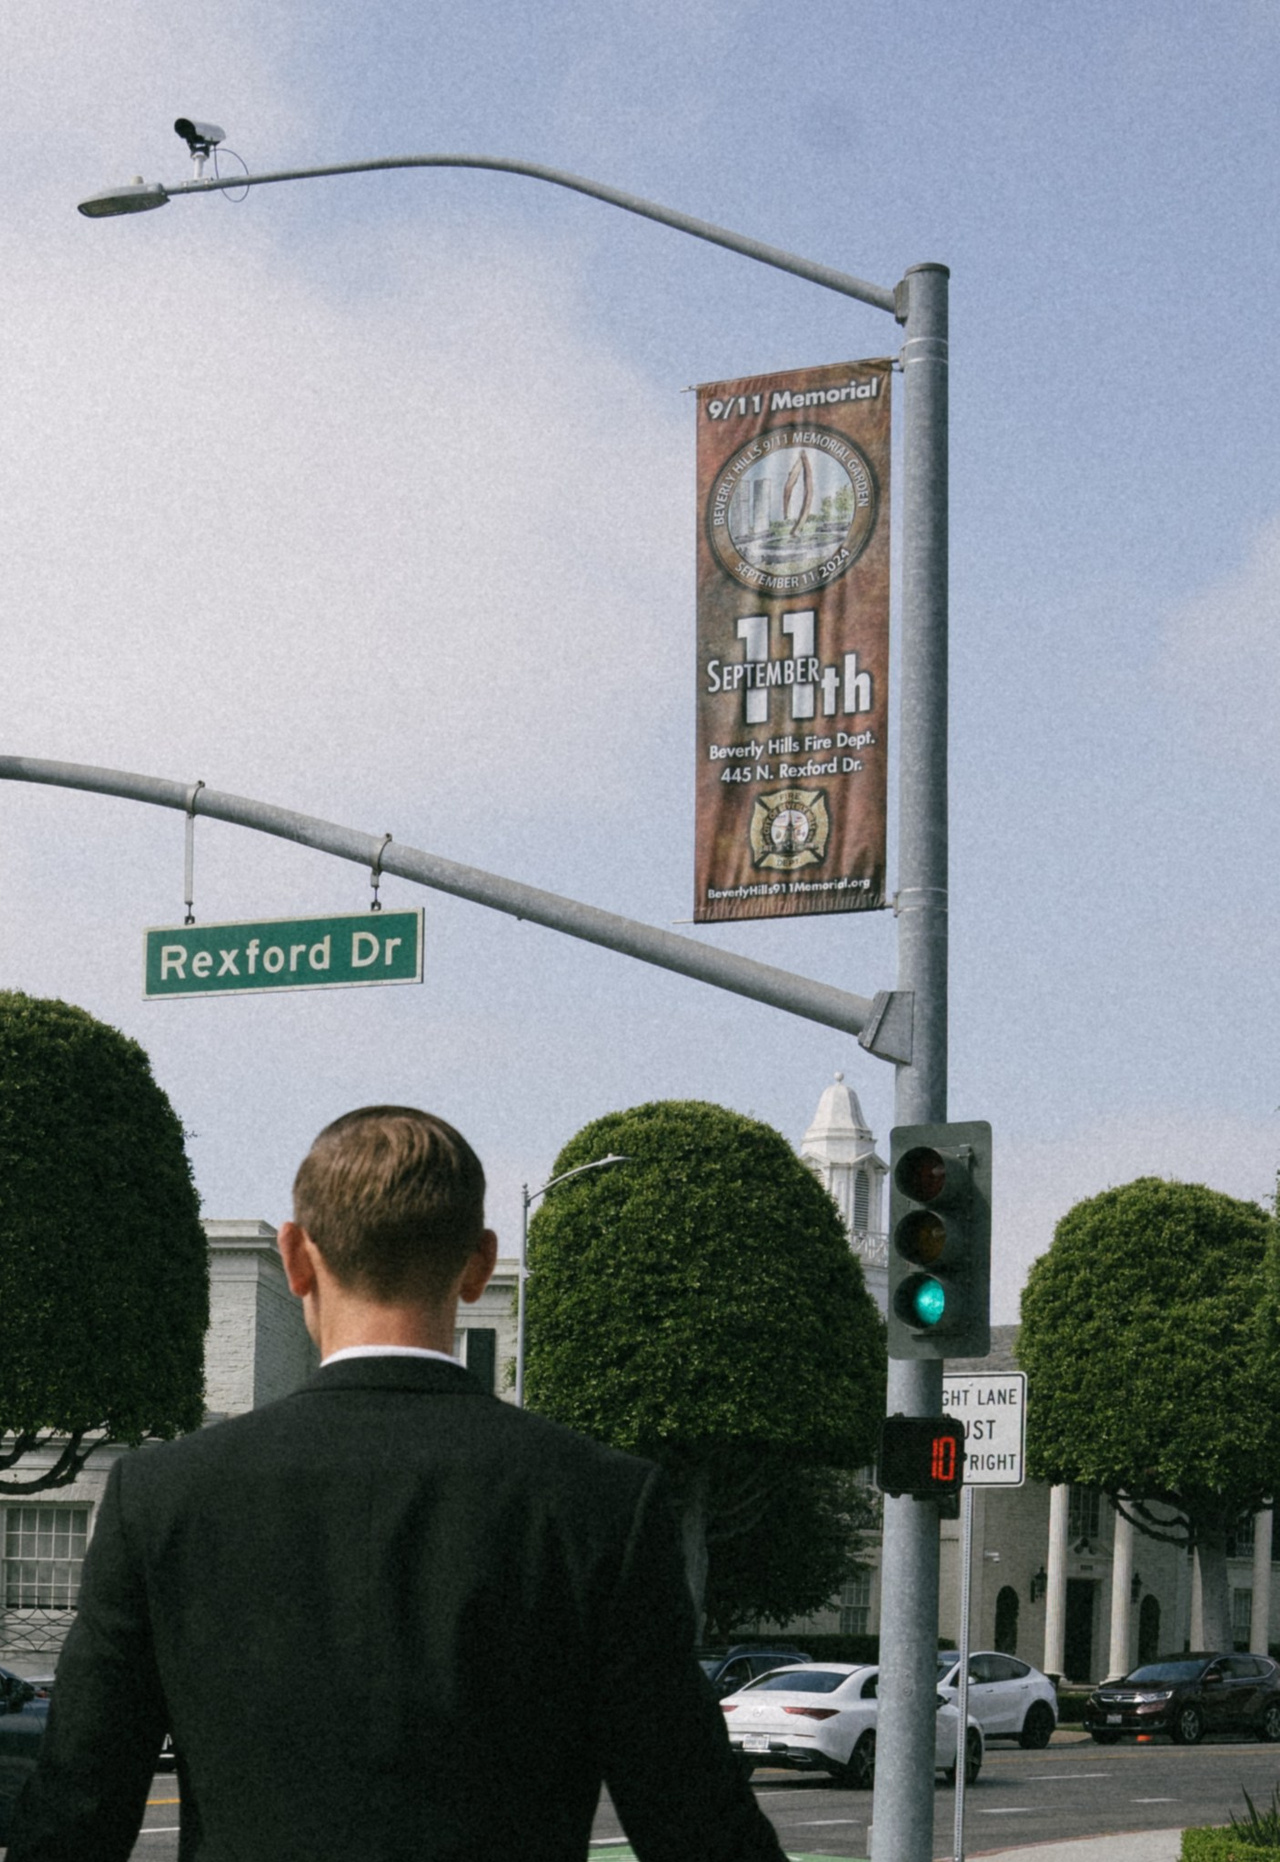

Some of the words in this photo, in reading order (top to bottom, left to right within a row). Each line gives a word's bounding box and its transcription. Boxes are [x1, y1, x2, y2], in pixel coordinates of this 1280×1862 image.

[708, 395, 762, 420] 9/11
[771, 377, 878, 411] Memorial
[713, 473, 735, 526] BEVERLY
[732, 446, 762, 474] HILLS
[762, 433, 788, 452] 9/11
[792, 431, 851, 461] MEMORIAL
[847, 458, 869, 507] GARDEN
[734, 561, 799, 589] SEPTEMBER
[819, 548, 851, 578] 2024
[706, 657, 820, 693] SEPTEMBER
[736, 610, 871, 724] 11th
[709, 740, 763, 760] Beverly
[768, 736, 800, 755] Hills
[804, 735, 832, 751] Fire
[837, 731, 876, 749] Dept.
[721, 767, 751, 783] 445
[756, 765, 774, 780] N.
[779, 757, 837, 779] Rexford
[842, 757, 862, 772] Dr.
[708, 877, 871, 899] BeverlyHills911Memorial.org
[160, 934, 332, 981] Rexford
[351, 931, 402, 969] Dr
[941, 1389, 970, 1406] GHT
[977, 1388, 1018, 1406] LANE
[964, 1419, 996, 1441] UST
[931, 1435, 956, 1482] 10
[969, 1453, 1017, 1471] RIGHT
